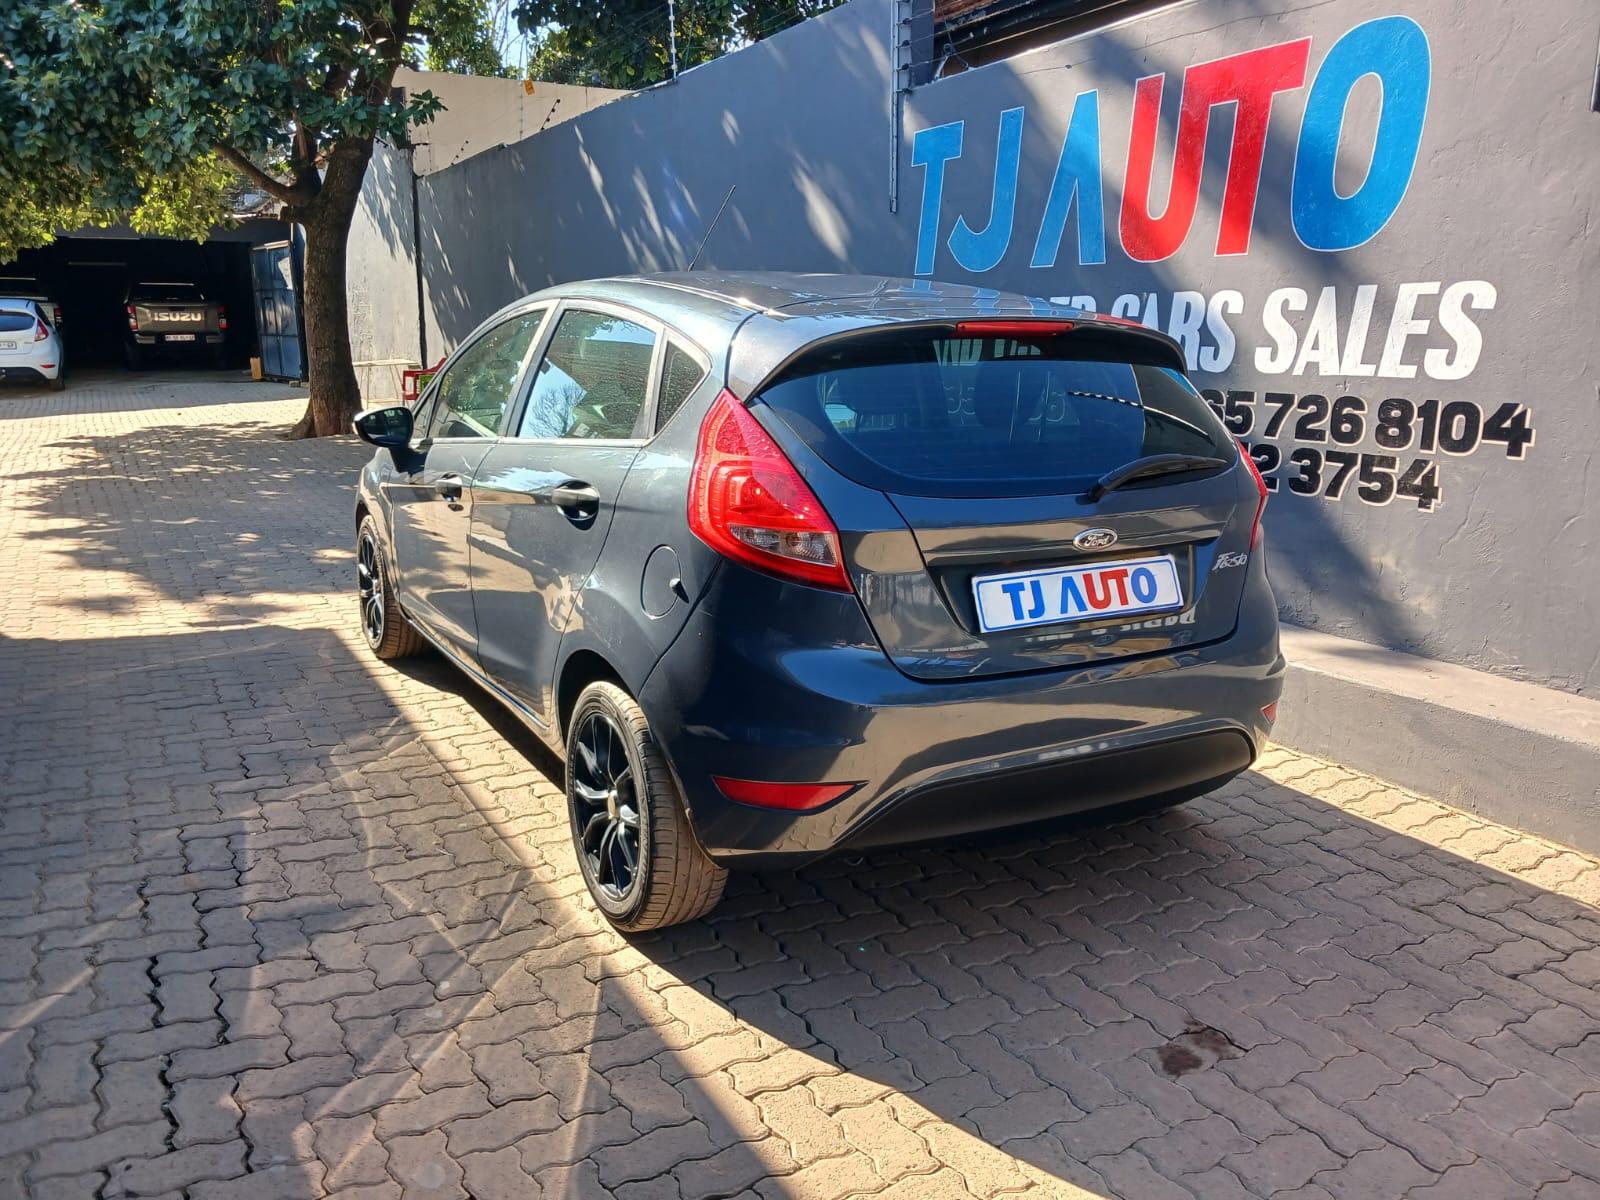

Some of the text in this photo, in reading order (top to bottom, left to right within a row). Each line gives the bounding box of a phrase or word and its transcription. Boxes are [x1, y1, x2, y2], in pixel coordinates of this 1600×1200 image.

[912, 15, 1431, 275] TJ AUTO
[154, 312, 202, 322] ISUZU
[1110, 280, 1498, 380] RS SALES
[1263, 392, 1369, 444] 726
[1374, 397, 1533, 460] 8104
[1240, 441, 1441, 512] 2 3754
[1002, 567, 1158, 620] TJ AUTO
